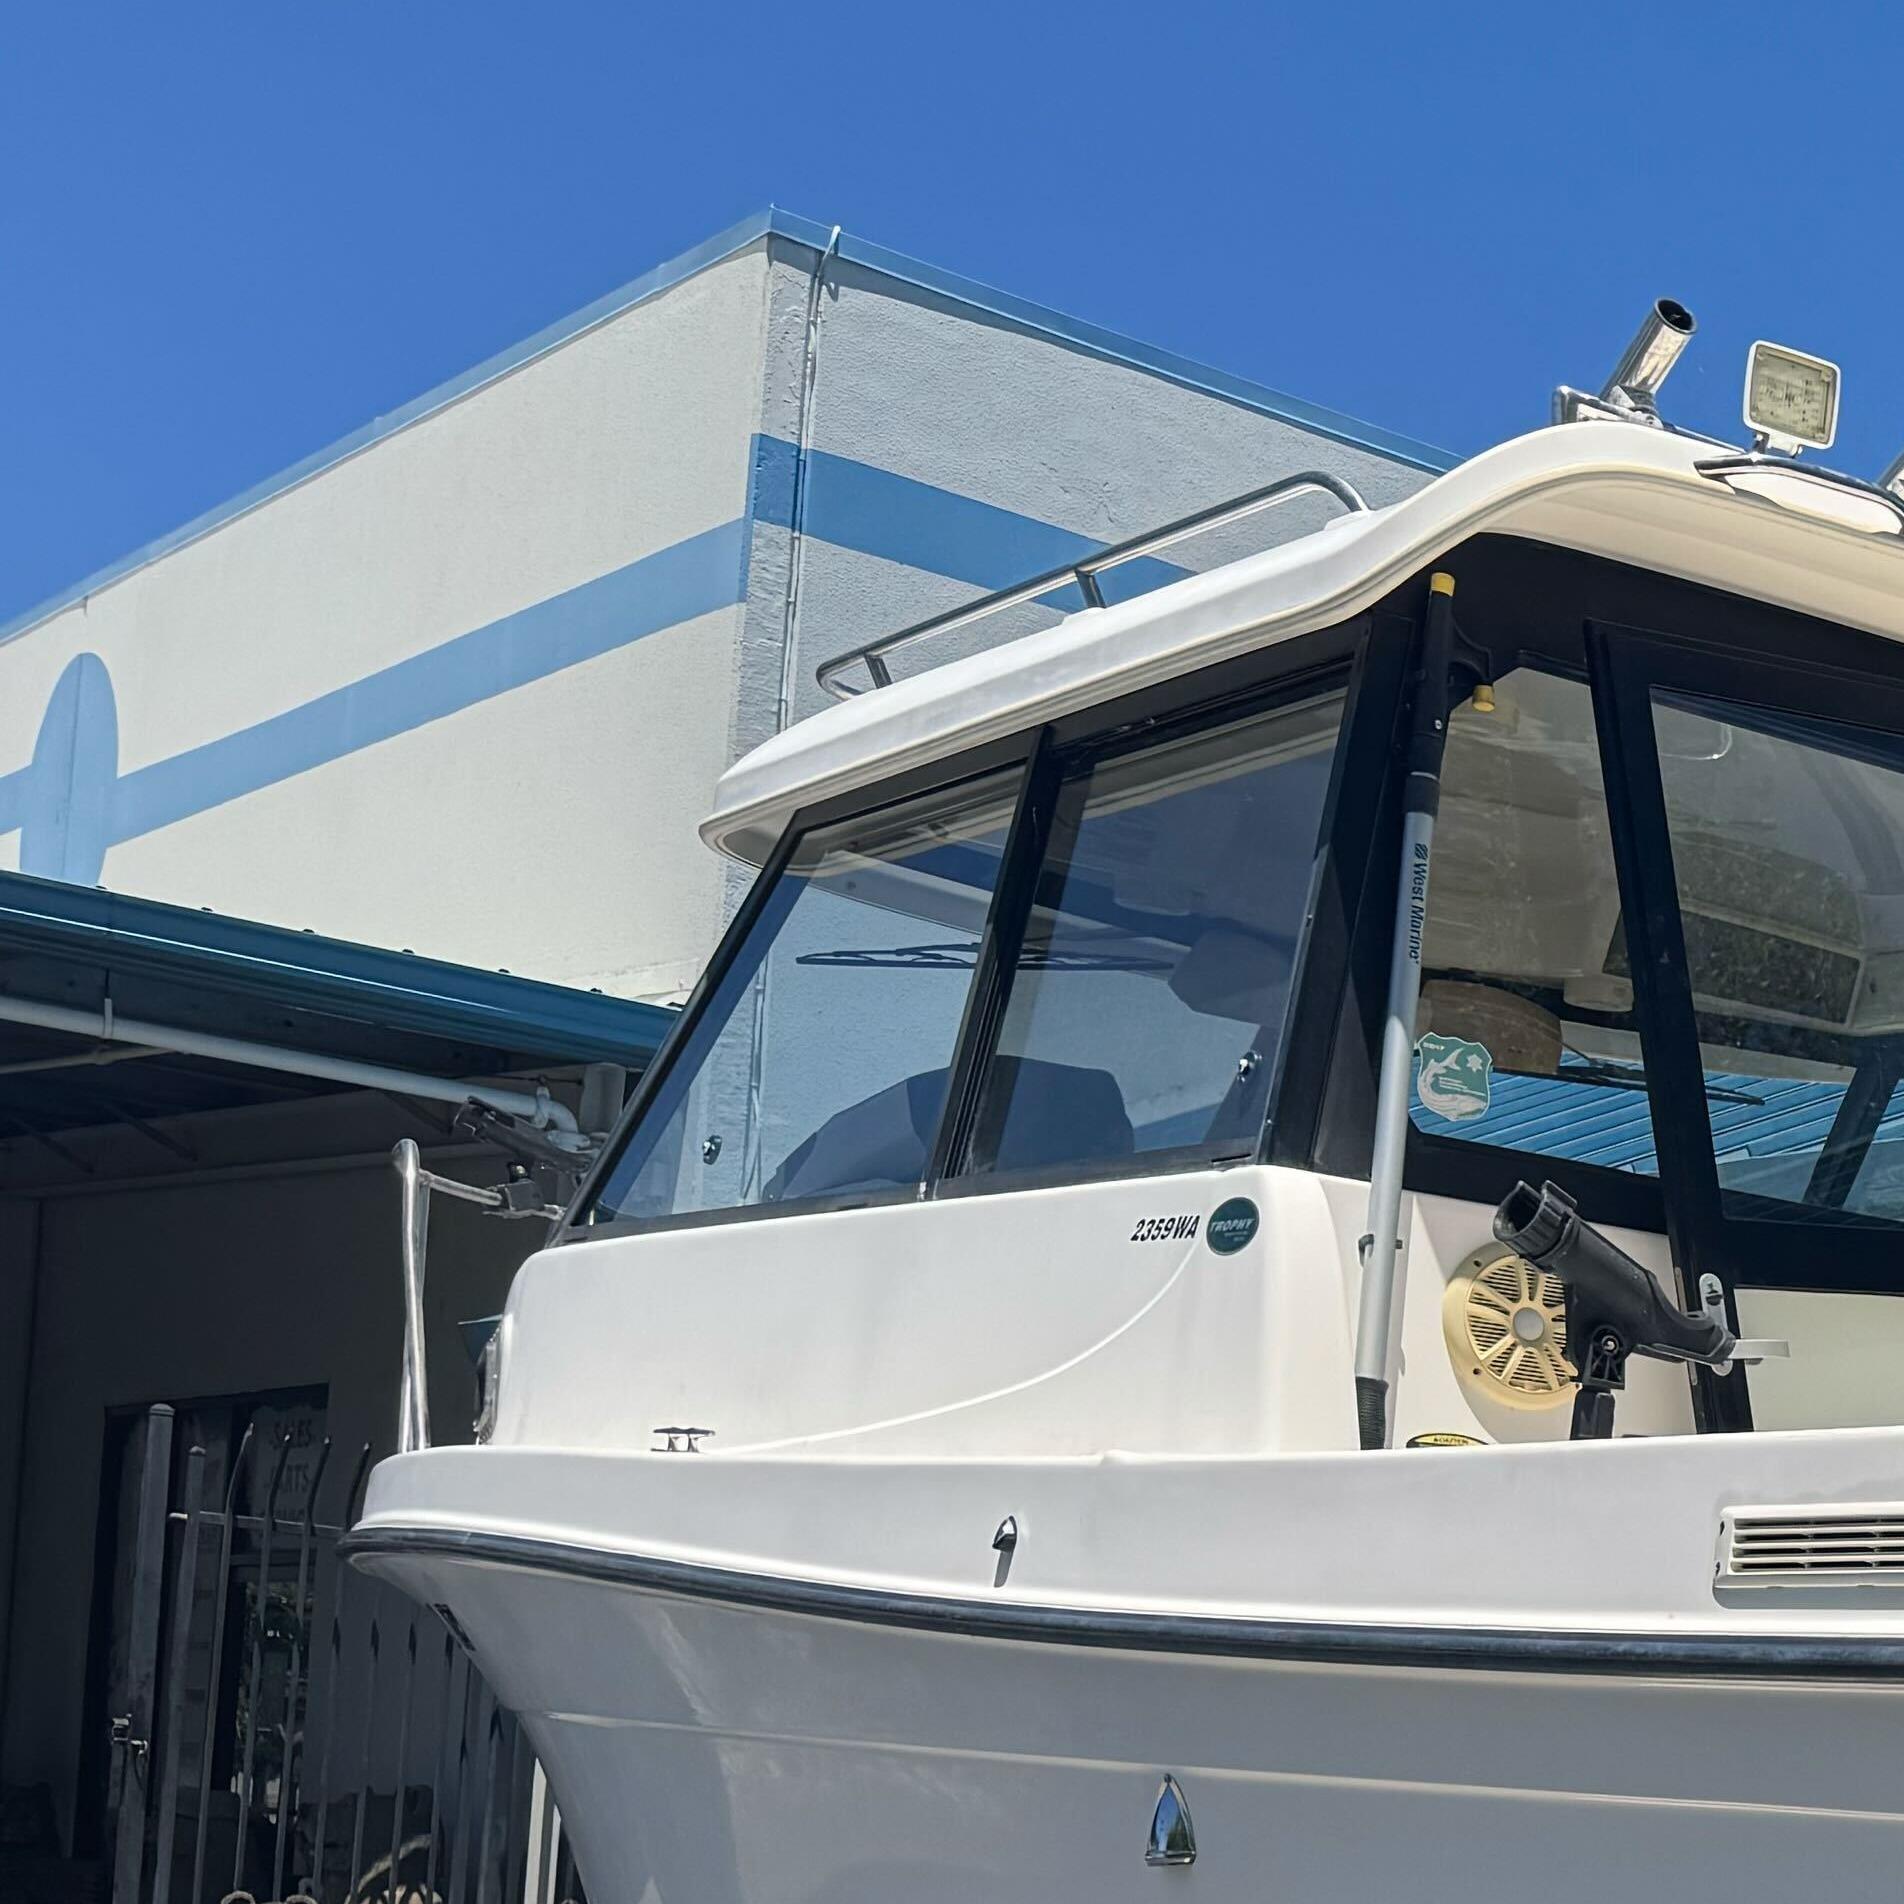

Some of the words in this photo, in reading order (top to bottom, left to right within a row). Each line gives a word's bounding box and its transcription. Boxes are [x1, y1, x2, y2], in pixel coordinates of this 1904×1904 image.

[1411, 863, 1428, 902] West
[1409, 904, 1425, 960] Marine
[1130, 1214, 1201, 1242] 2359WA
[1209, 1218, 1256, 1233] TROPHY
